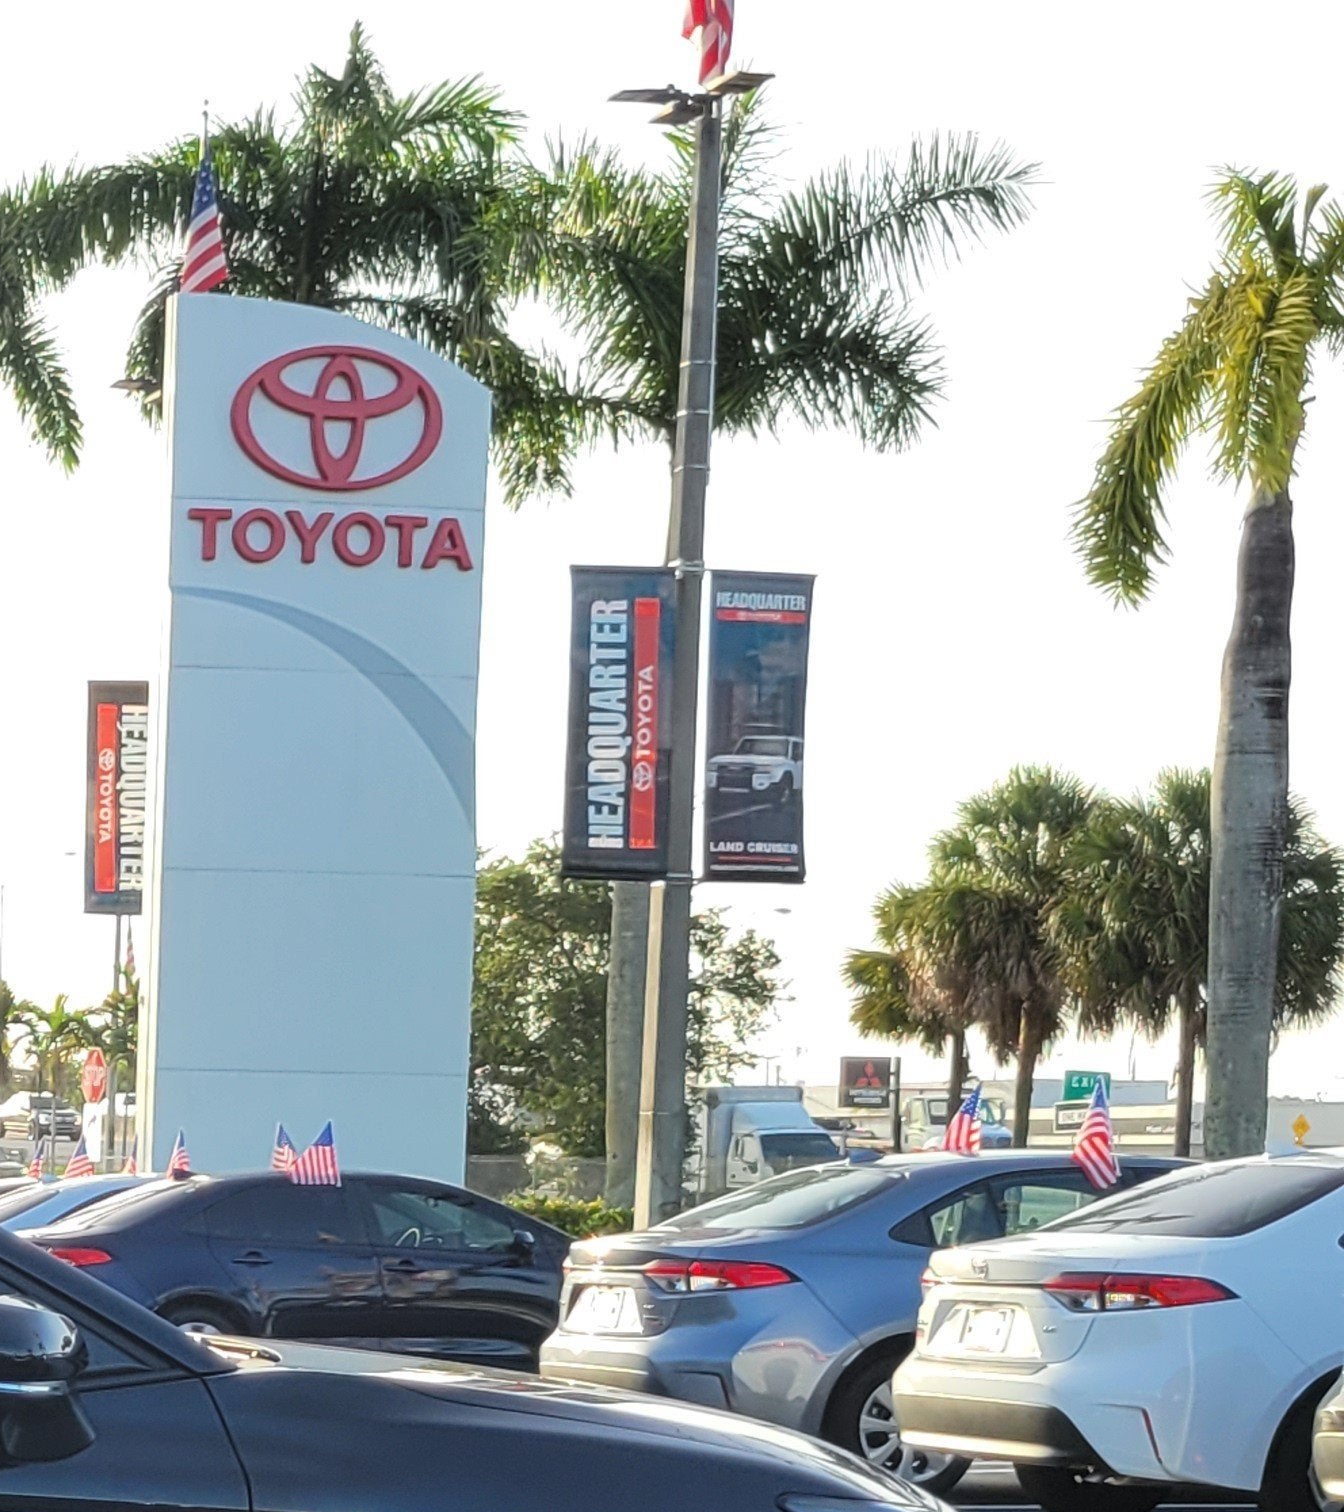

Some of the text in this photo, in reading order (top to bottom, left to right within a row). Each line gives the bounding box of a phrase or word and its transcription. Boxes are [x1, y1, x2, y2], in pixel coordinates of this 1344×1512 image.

[188, 508, 473, 571] TOYOTA
[716, 591, 806, 612] HEADQUARTER
[587, 599, 632, 849] HEADQUARTER
[636, 665, 655, 759] TOYOTA
[99, 772, 114, 844] TOYOTA
[116, 704, 148, 892] HEADQUARTER
[709, 841, 744, 852] LAND
[1071, 1076, 1095, 1088] EXI
